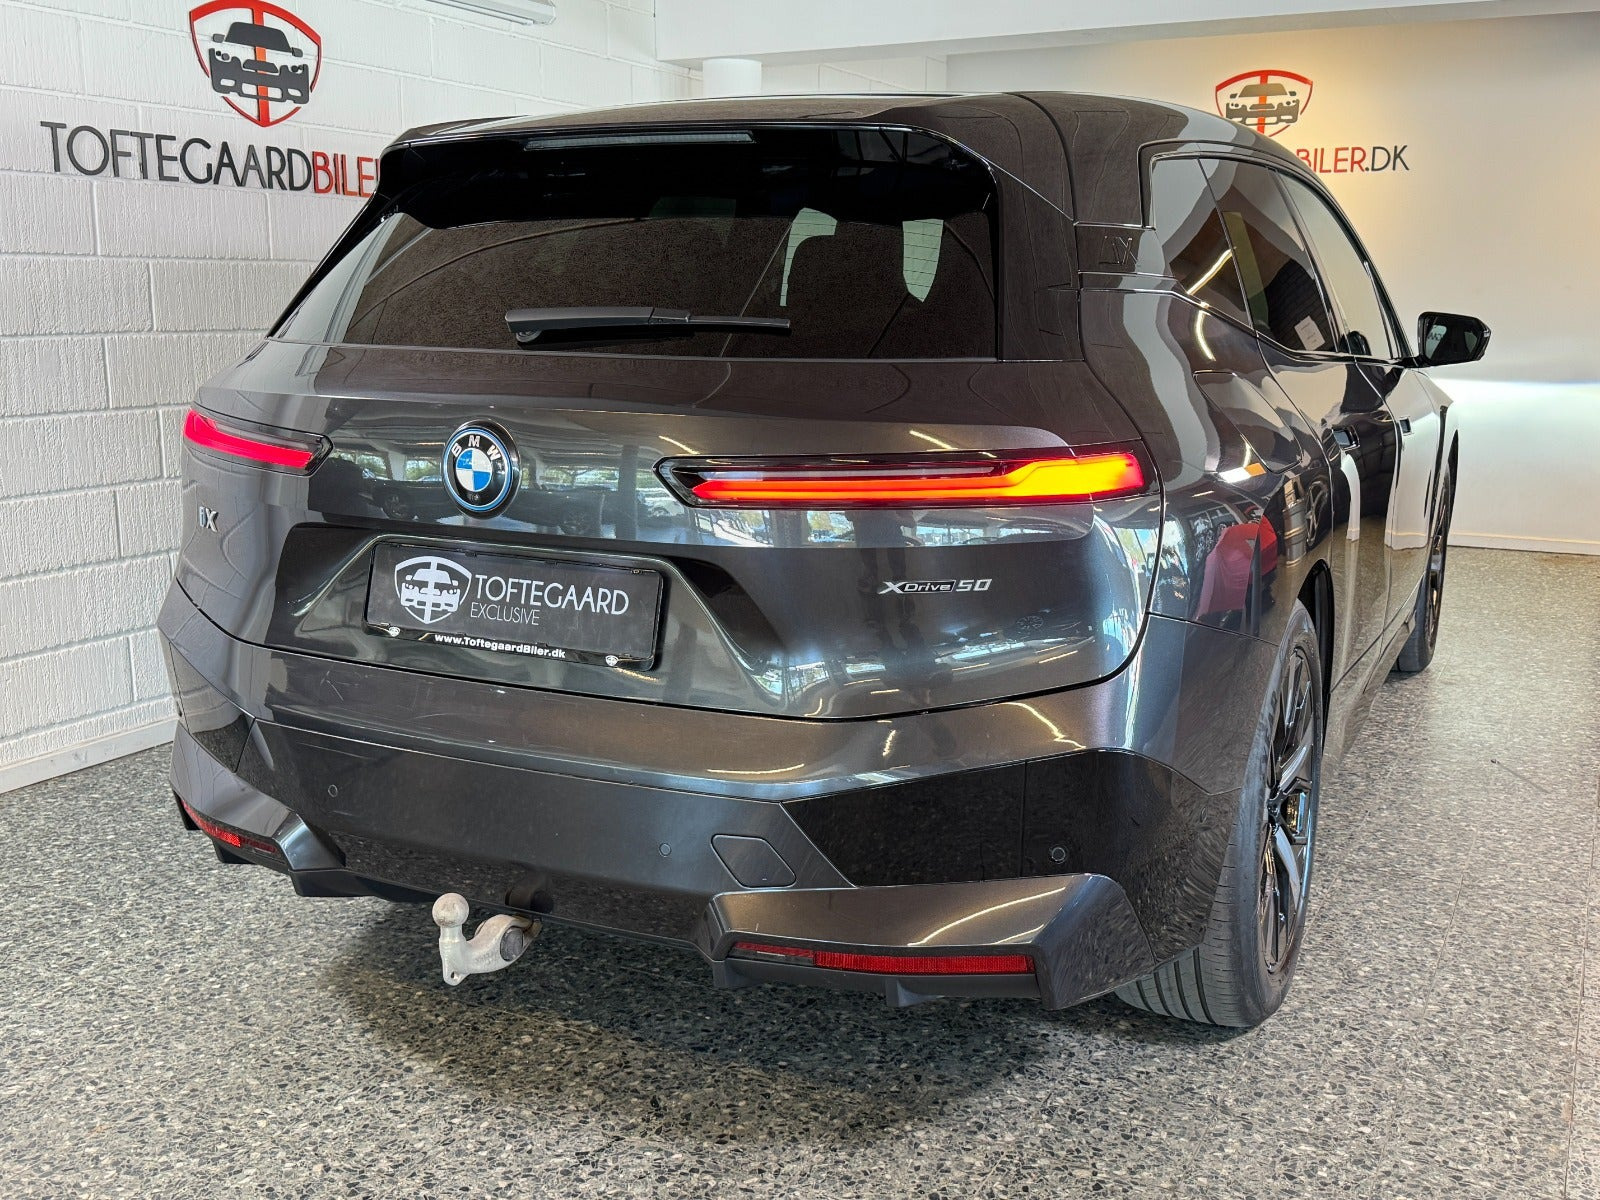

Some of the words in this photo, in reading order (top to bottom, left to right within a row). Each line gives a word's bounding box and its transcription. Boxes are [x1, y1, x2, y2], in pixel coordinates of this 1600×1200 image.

[451, 434, 501, 461] BMW
[474, 574, 630, 616] TOFTEGAARD
[470, 602, 541, 626] EXCLUSIVE
[434, 633, 566, 658] www.ToftegaardBiler.dk
